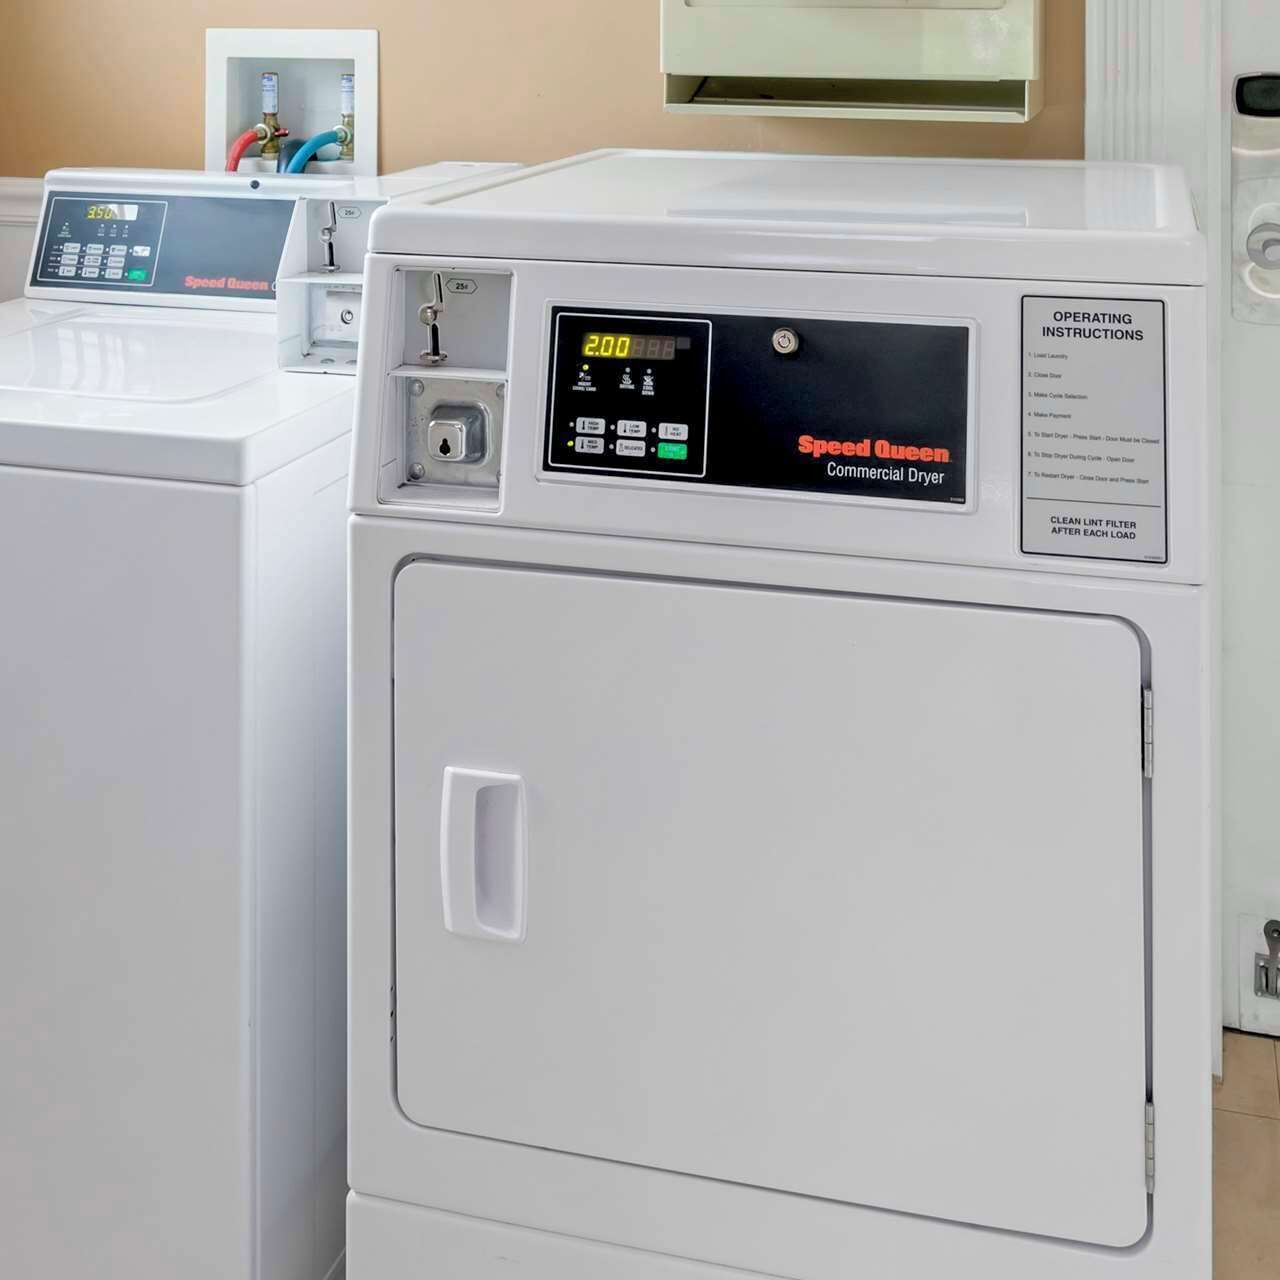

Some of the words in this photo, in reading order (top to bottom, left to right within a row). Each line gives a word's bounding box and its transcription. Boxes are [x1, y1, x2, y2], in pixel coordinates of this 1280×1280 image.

[184, 275, 226, 289] Speed
[227, 277, 269, 291] Queen
[1053, 311, 1133, 325] OPERATING
[1042, 326, 1144, 341] INSTRUCTIONS
[584, 335, 631, 357] 2.00
[798, 434, 871, 458] Speed
[874, 439, 950, 463] Queen
[1054, 452, 1068, 460] Dryer
[1069, 453, 1087, 461] During
[827, 461, 904, 481] Commercial
[908, 467, 945, 487] Dryer
[1050, 516, 1081, 525] CLEAN
[1083, 518, 1103, 527] LINT
[1105, 519, 1137, 529] FILTER
[1051, 526, 1081, 535] AFTER
[1083, 528, 1108, 538] EACH
[1110, 530, 1136, 540] LOAD
